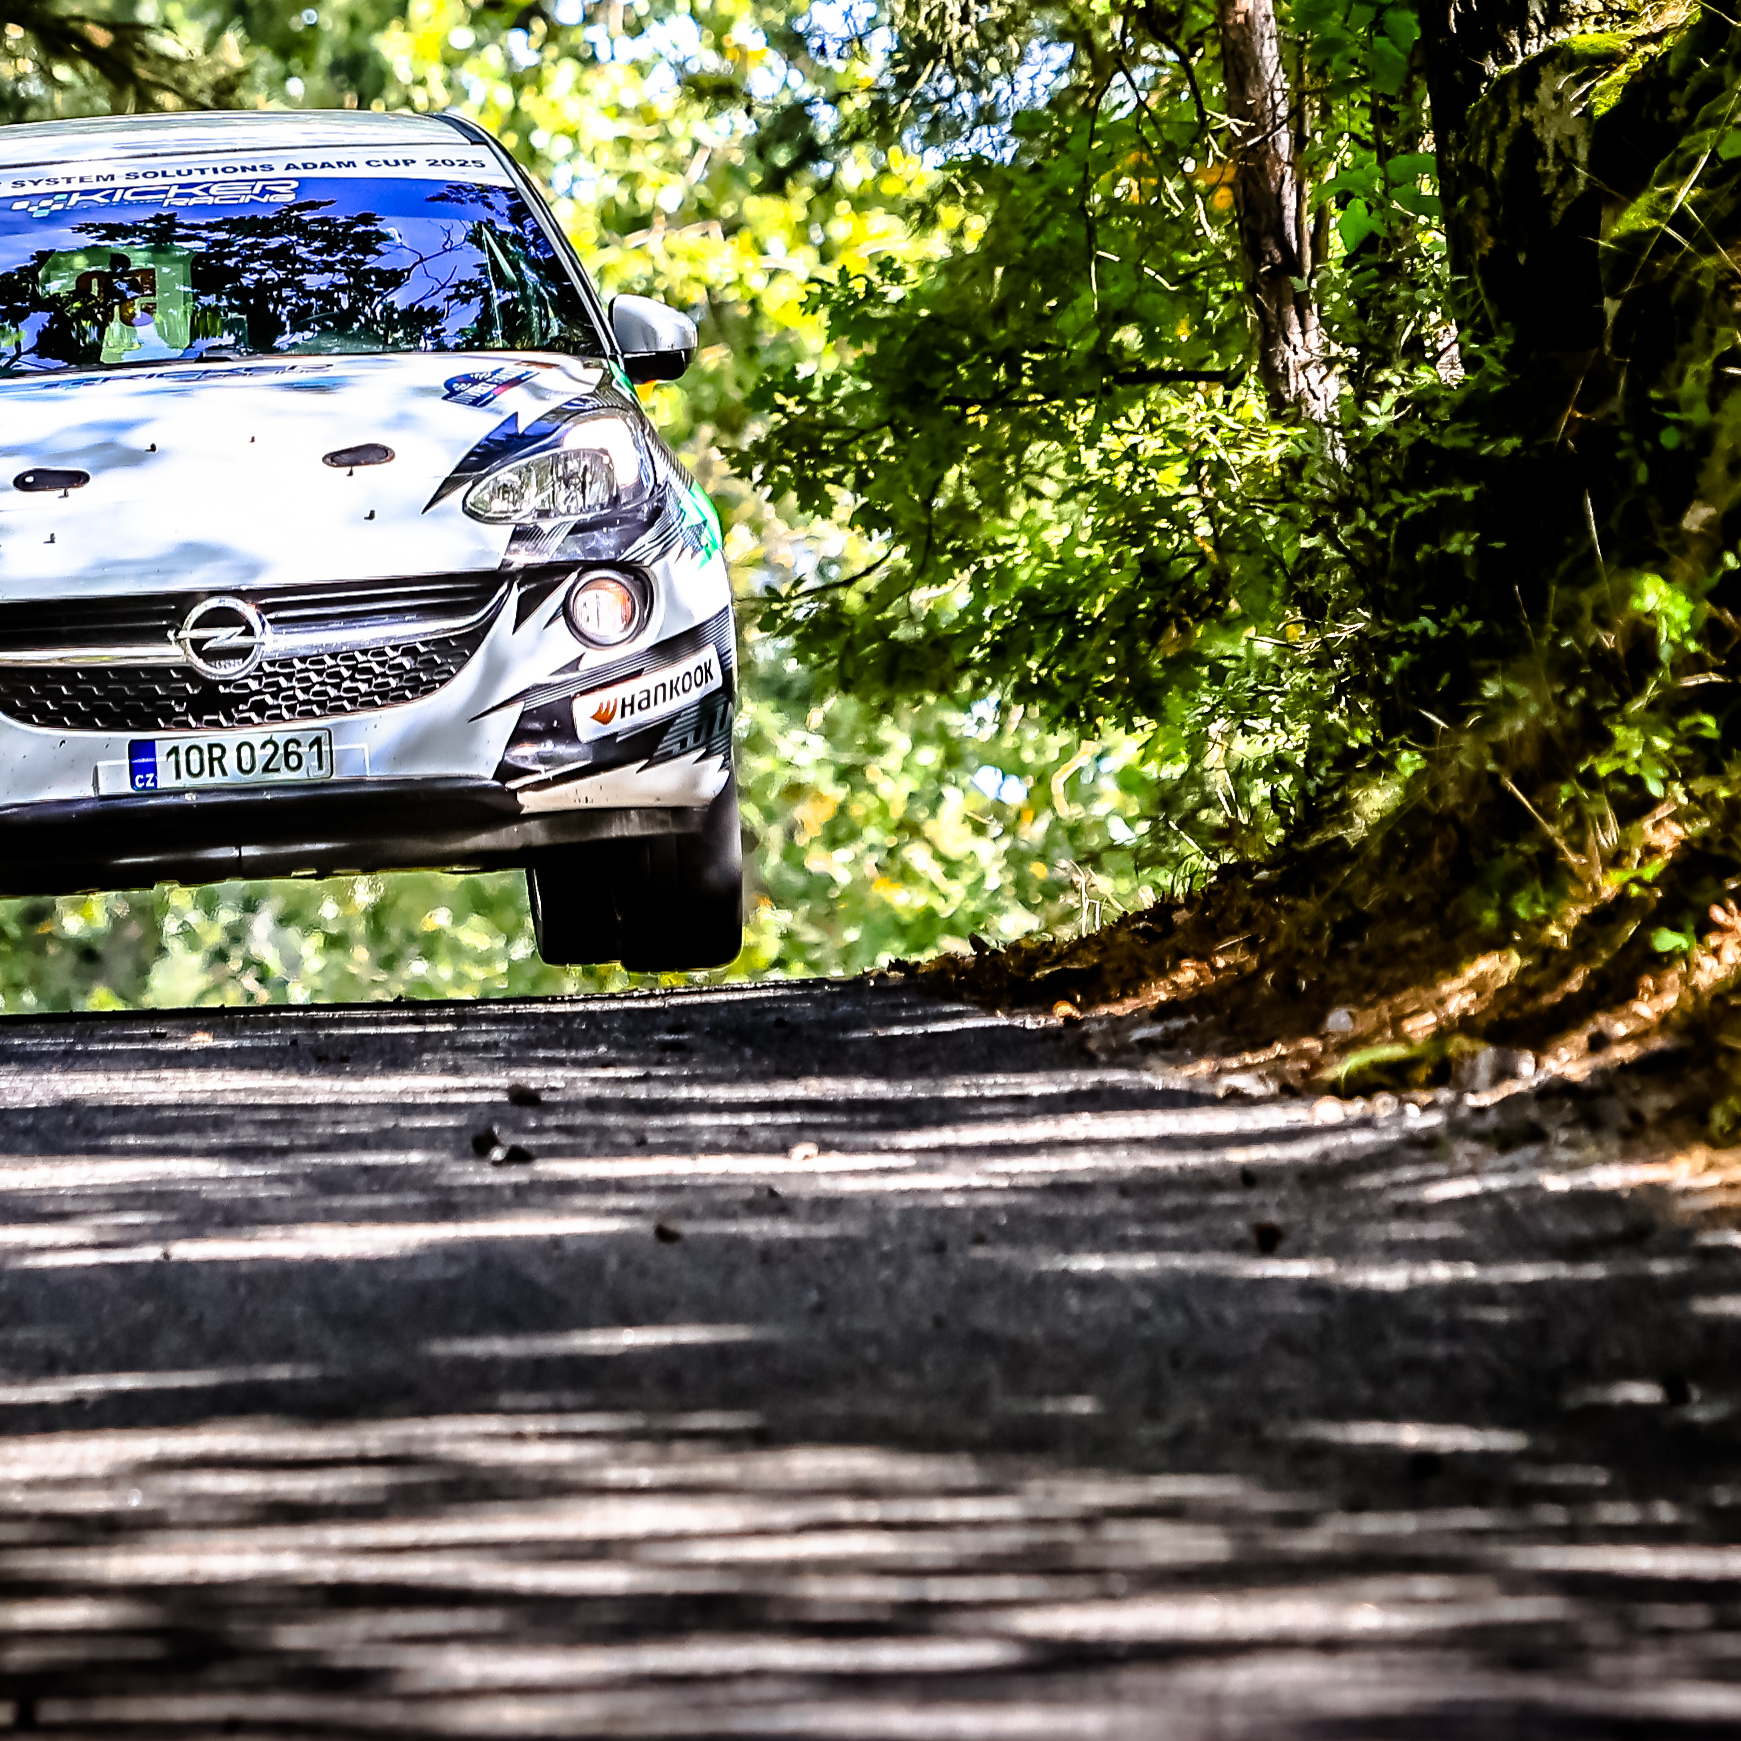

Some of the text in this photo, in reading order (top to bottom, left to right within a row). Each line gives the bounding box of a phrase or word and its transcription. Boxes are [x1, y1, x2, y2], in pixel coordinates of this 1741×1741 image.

[10, 172, 116, 189] SYSTEM
[124, 163, 276, 181] SOLUTIONS
[283, 159, 358, 172] ADAM
[365, 158, 417, 168] CUP
[425, 158, 487, 169] 2025
[66, 179, 300, 207] KICKER
[162, 193, 297, 208] RACING
[165, 735, 325, 781] 10R 0261
[134, 772, 156, 789] CZ
